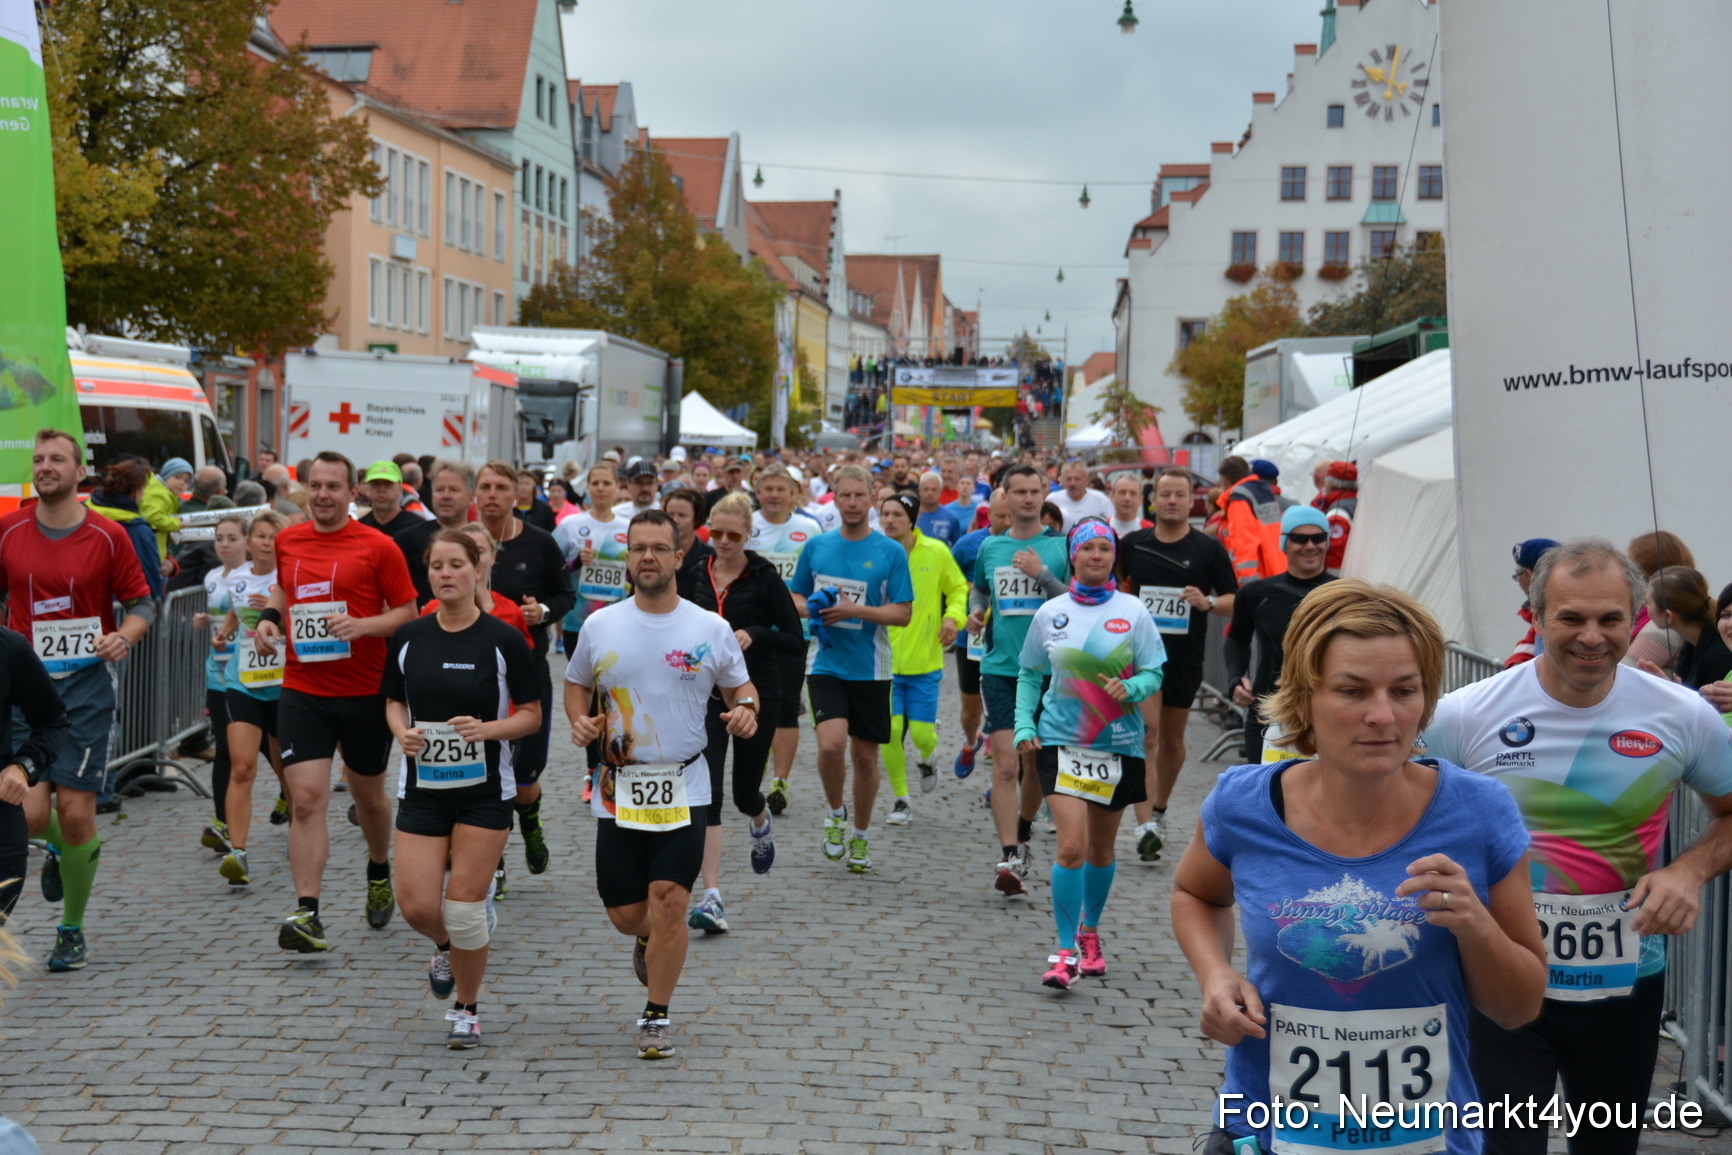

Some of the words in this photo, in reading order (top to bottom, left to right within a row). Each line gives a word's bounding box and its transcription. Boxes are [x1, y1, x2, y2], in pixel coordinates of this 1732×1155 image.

[1503, 358, 1732, 391] www.bmw-laufspo
[932, 392, 975, 403] START
[366, 403, 426, 415] Bayerisches
[366, 417, 394, 425] Rotes
[365, 428, 393, 438] Kreuz
[585, 568, 621, 585] 2698
[999, 578, 1042, 596] 2414
[1145, 597, 1186, 616] 2746
[296, 618, 333, 639] 263
[42, 633, 95, 656] 2473
[302, 644, 335, 653] Andreas
[62, 661, 80, 670] Tim
[680, 673, 696, 681] 2012
[1111, 723, 1126, 733] 16.
[421, 739, 478, 762] 2254
[1616, 736, 1657, 750] Hervis
[1496, 752, 1535, 760] PARTL
[433, 769, 464, 779] Carina
[1071, 760, 1109, 780] 310
[631, 780, 673, 806] 528
[1074, 779, 1100, 793] Claudia
[621, 807, 687, 824] BIRGER
[1268, 896, 1347, 927] Sunny
[1353, 900, 1427, 925] Place
[1535, 902, 1557, 914] RTL
[1561, 904, 1616, 916] Neumarkt
[1550, 969, 1602, 987] Martin
[1276, 1019, 1330, 1040] PARTL
[1335, 1025, 1417, 1041] Neumarkt
[1289, 1045, 1433, 1104] 2113
[1331, 1121, 1391, 1143] Petra
